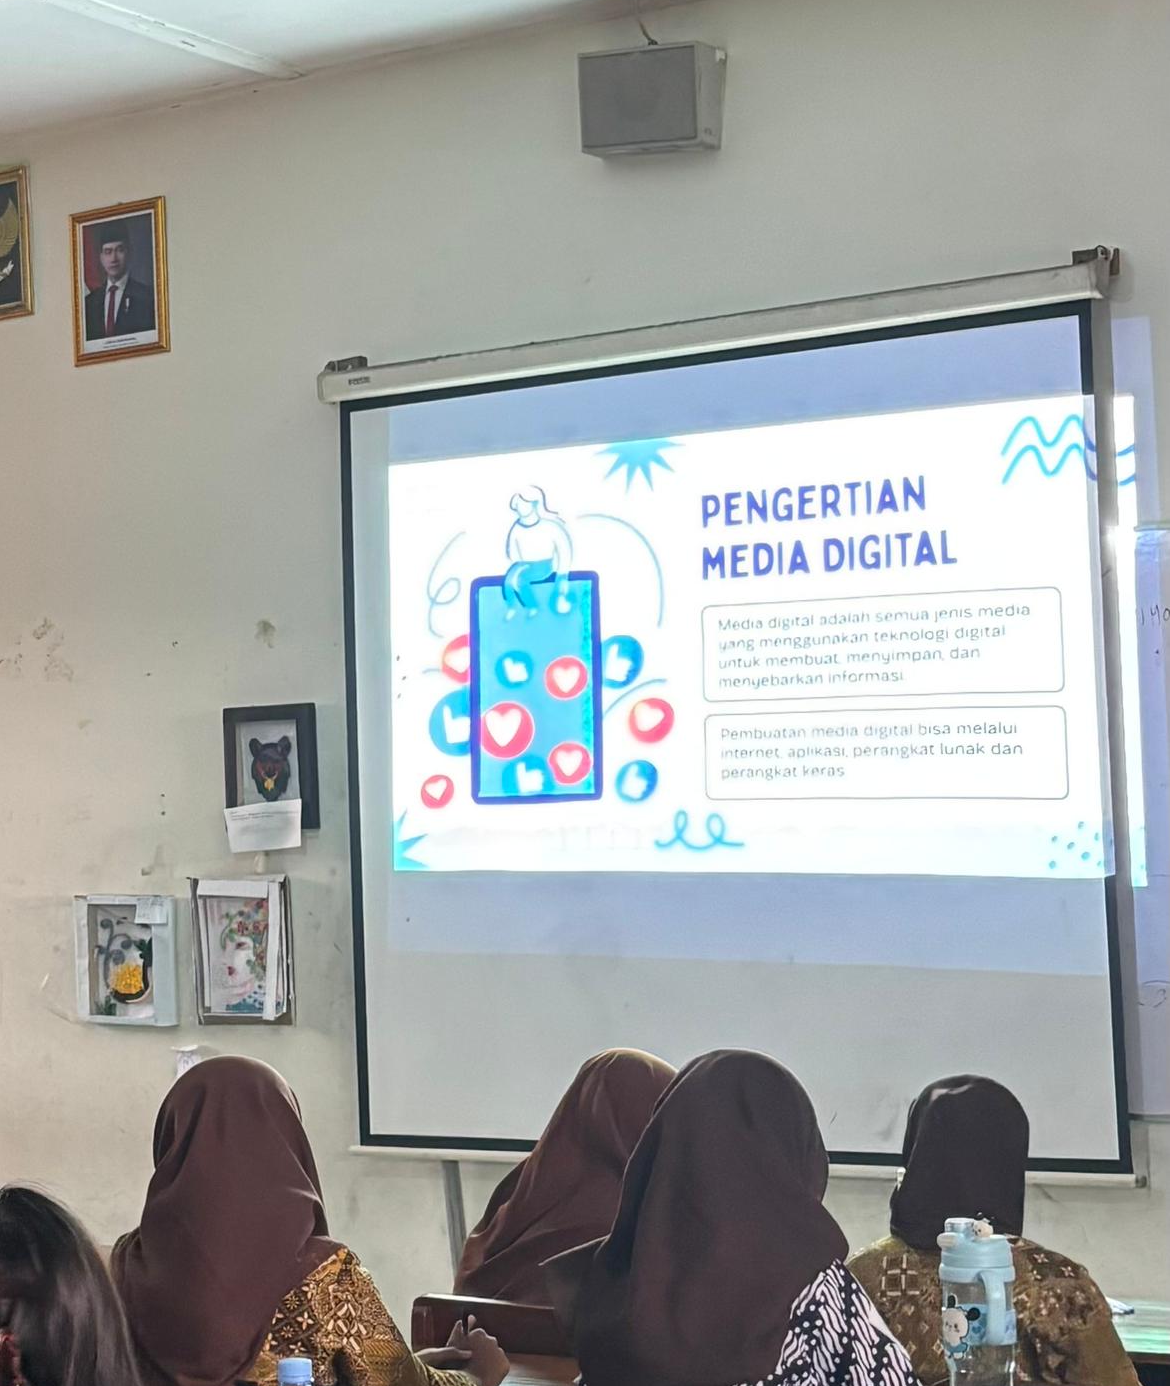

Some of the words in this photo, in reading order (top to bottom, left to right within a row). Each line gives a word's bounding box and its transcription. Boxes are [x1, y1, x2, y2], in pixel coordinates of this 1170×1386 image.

[701, 475, 926, 528] PENGERTIAN
[702, 539, 811, 580] MEDIA
[823, 529, 958, 573] DIGITAL
[718, 618, 764, 631] Media
[768, 614, 815, 631] digital
[819, 611, 871, 625] adalah
[875, 611, 930, 623] semua
[934, 606, 974, 624] jenis
[978, 603, 1031, 618] media
[718, 636, 755, 653] yang
[759, 630, 869, 650] menggunakan
[874, 626, 950, 643] teknologi
[954, 624, 1007, 641] digital
[718, 656, 760, 670] untuk
[950, 645, 981, 659] dan
[718, 671, 824, 690] menyebarkan
[720, 725, 807, 741] Pembuatan
[811, 724, 859, 738] media
[863, 723, 914, 741] digital
[917, 722, 951, 735] bisa
[956, 721, 1018, 735] melalui
[787, 744, 850, 761] aplikasi,
[853, 743, 935, 760] perangkat
[940, 741, 986, 756] lunak
[990, 742, 1023, 756] dan
[720, 764, 798, 781] perangkat
